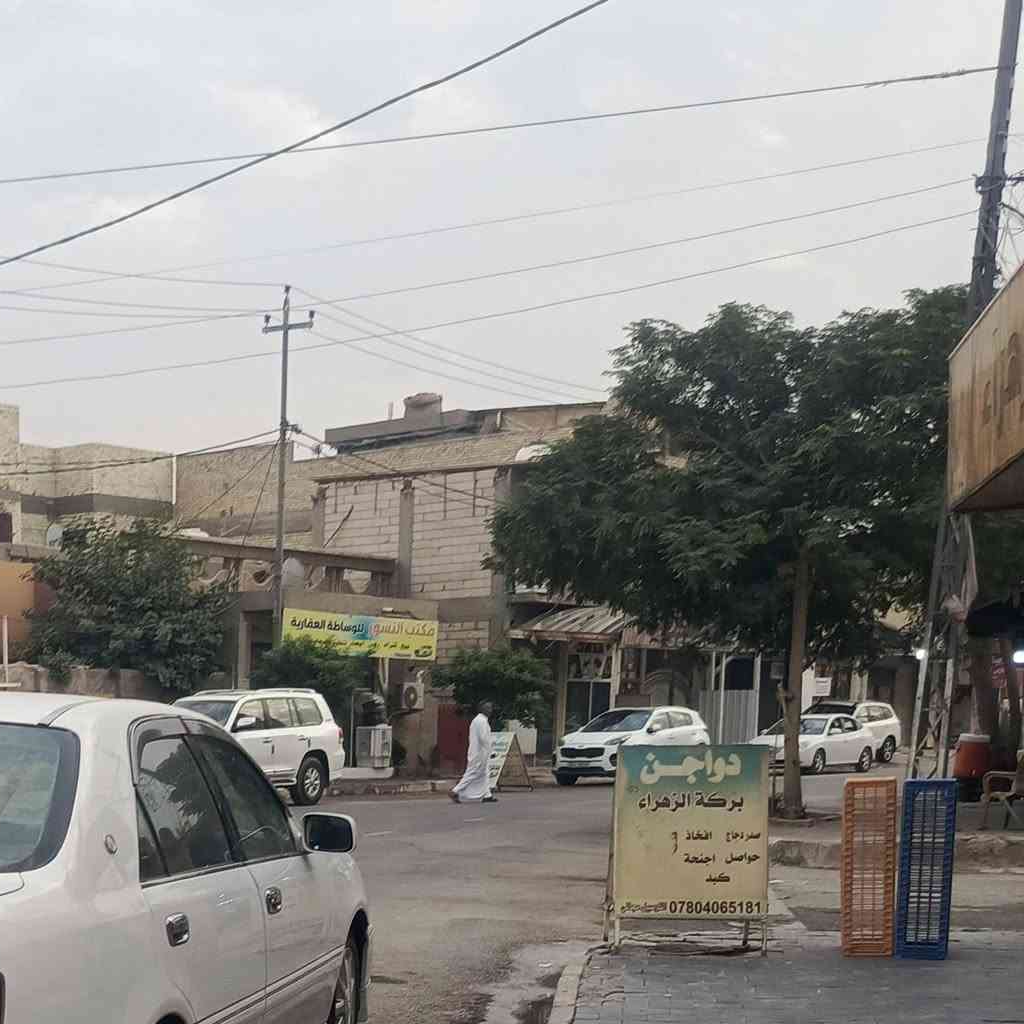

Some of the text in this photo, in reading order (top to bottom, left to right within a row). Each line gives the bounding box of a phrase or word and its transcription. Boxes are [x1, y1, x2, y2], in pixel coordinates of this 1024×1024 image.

[290, 615, 326, 631] العقارية
[327, 617, 366, 634] للوساطة
[405, 622, 435, 638] مكتب
[640, 750, 742, 785] دواجن
[638, 791, 744, 812] بركة الزهراء
[683, 851, 760, 865] حواصل اجنحة
[705, 872, 731, 886] كبد
[669, 901, 762, 915] 07804065181
